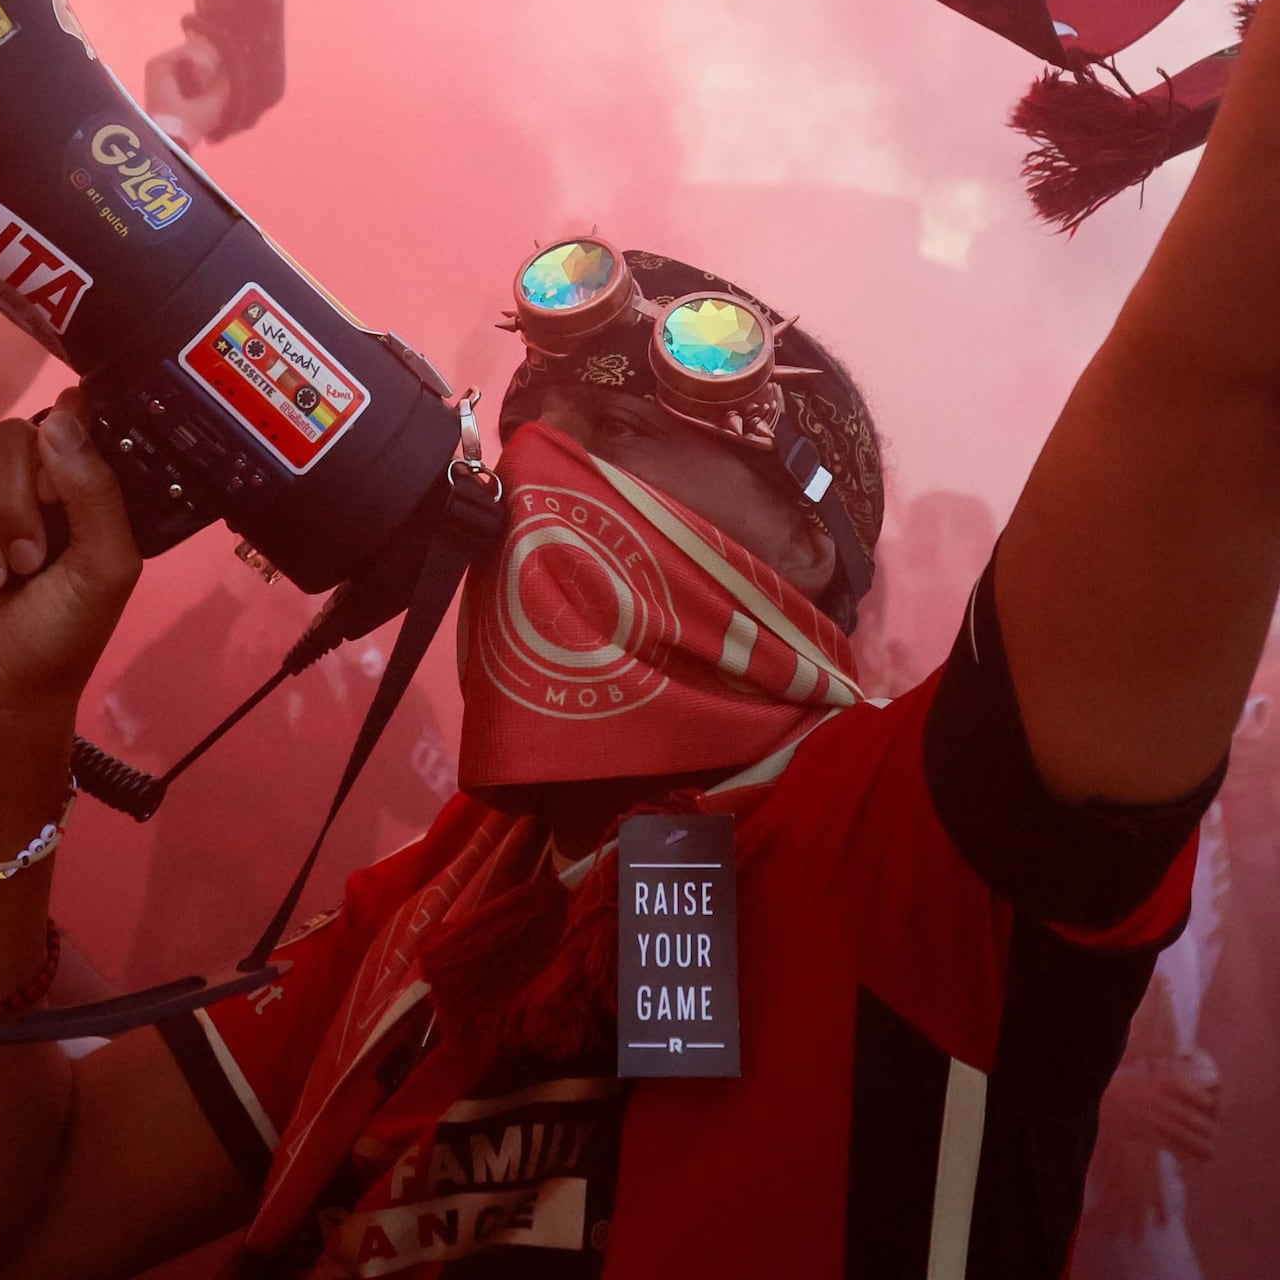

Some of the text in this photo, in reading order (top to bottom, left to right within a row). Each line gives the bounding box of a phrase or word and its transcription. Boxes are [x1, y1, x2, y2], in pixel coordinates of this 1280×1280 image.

[262, 322, 321, 379] We Ready
[227, 351, 277, 398] CASSETTE
[523, 494, 643, 567] FOOTIE
[545, 684, 625, 708] MOB
[634, 881, 714, 916] RAISE
[637, 933, 712, 968] YOUR
[636, 985, 713, 1021] GAME
[390, 1122, 599, 1200] FAMILY
